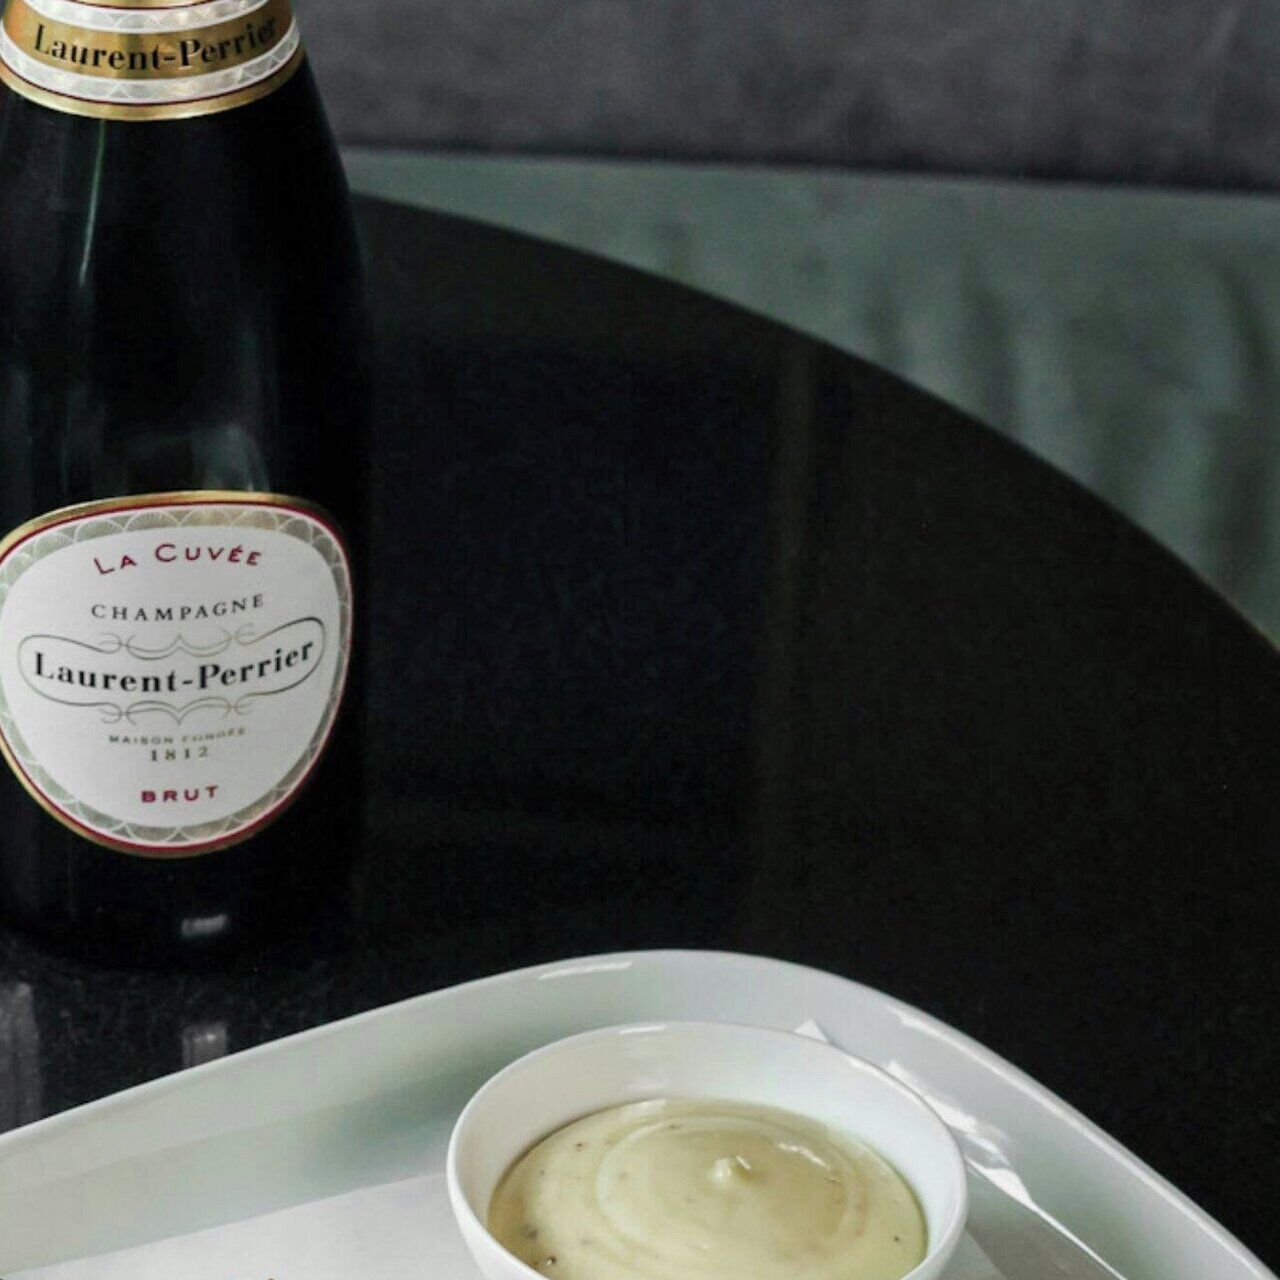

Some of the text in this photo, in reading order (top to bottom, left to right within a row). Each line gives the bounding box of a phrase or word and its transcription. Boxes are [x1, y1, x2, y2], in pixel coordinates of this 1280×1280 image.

[93, 556, 138, 576] LA
[90, 593, 265, 622] CHAMPAGNE
[33, 638, 315, 694] Laurent-Perrier
[150, 745, 209, 762] 1812
[141, 784, 219, 803] BRUT
